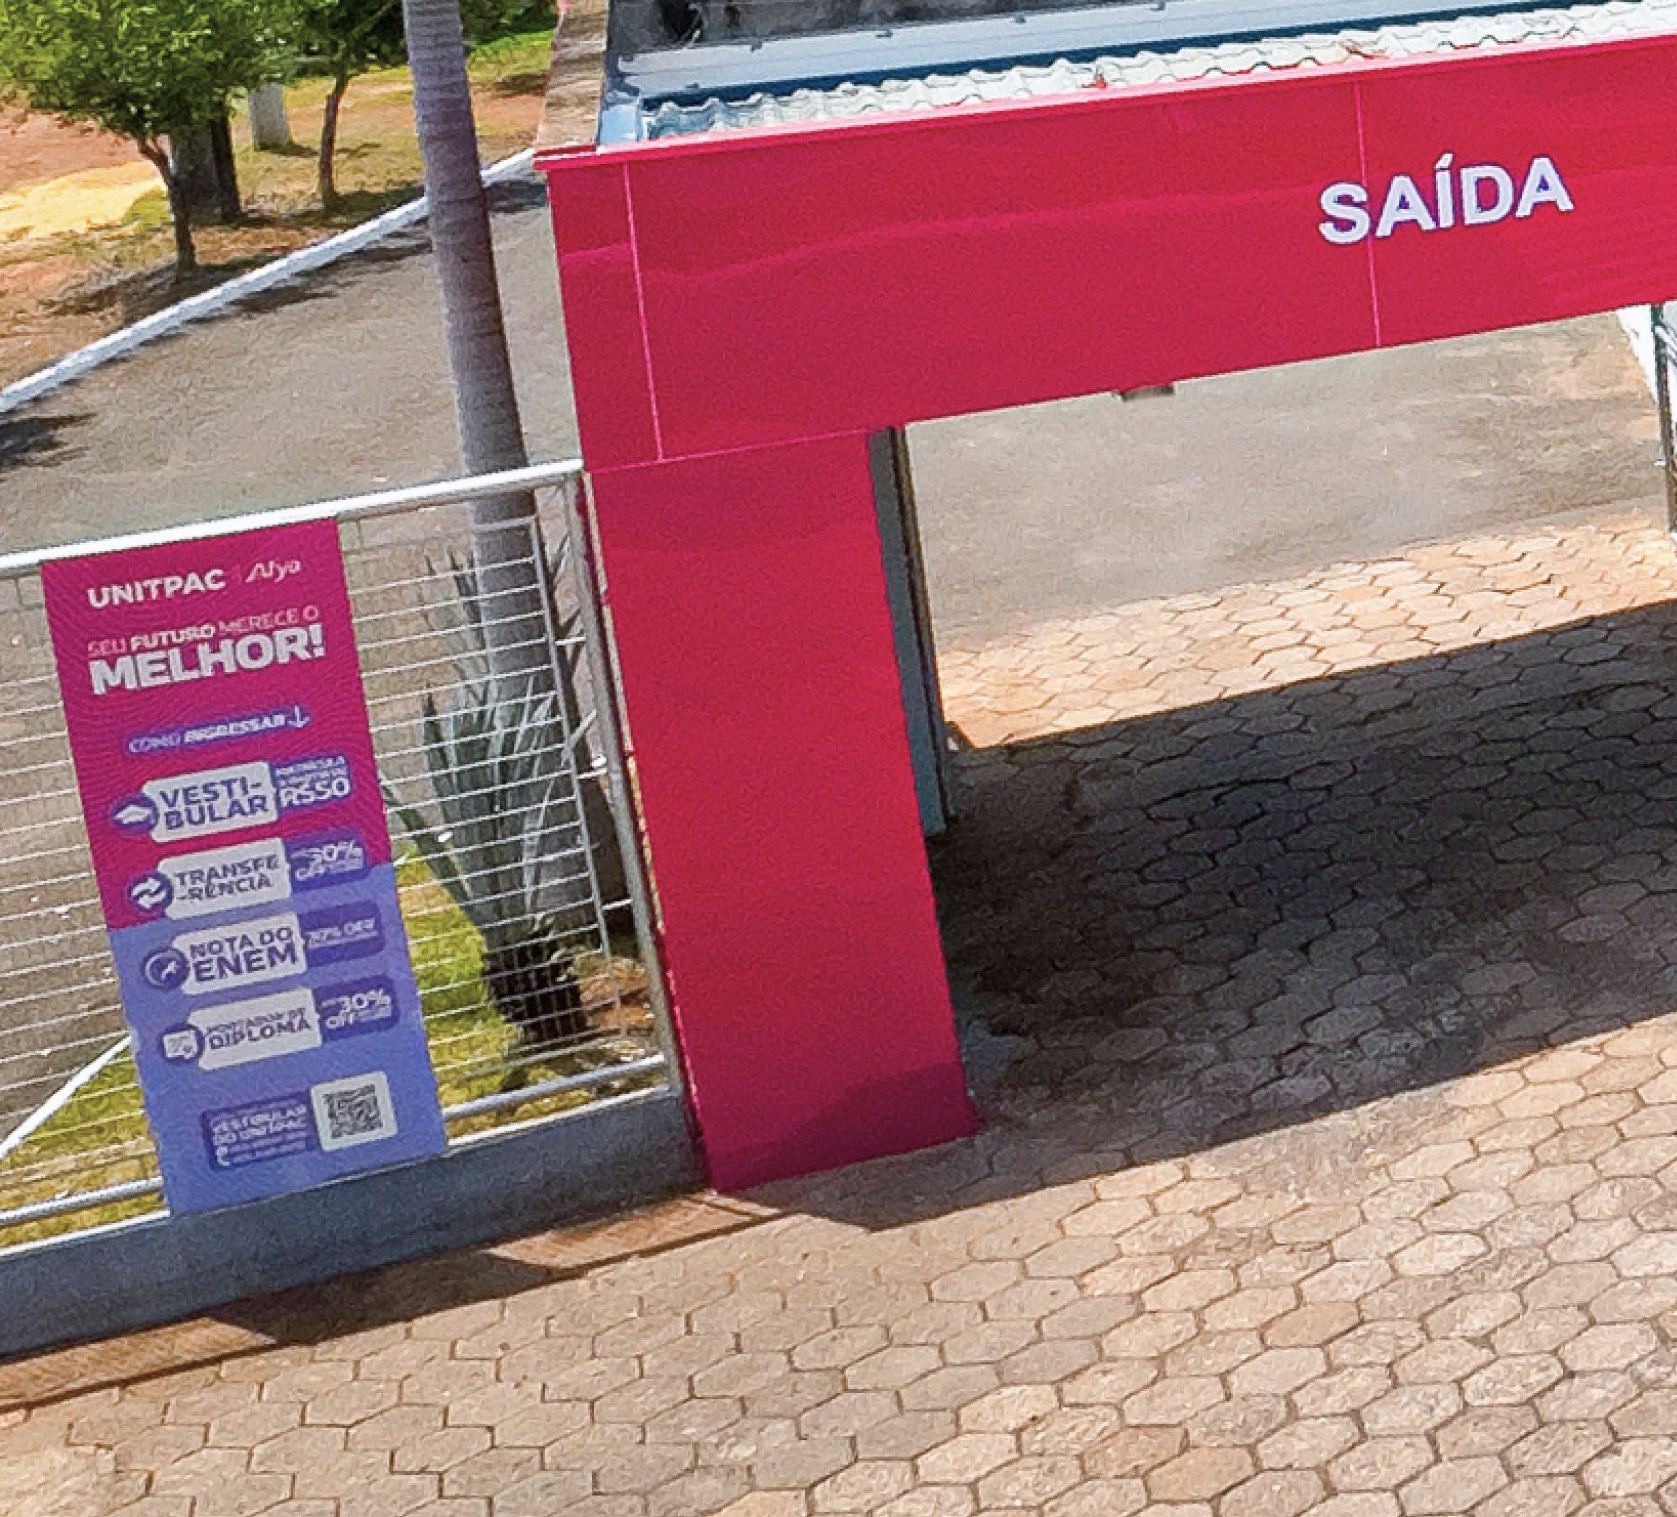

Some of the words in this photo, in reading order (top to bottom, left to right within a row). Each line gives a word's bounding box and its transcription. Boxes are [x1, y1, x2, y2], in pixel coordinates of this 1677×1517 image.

[1318, 152, 1575, 245] SAÍDA
[87, 569, 226, 609] UNITPAC
[87, 637, 127, 658] SEU
[131, 623, 216, 653] FUTURO
[218, 608, 299, 634] MERECE
[303, 604, 320, 622] O
[90, 623, 327, 695] MELHOR!
[159, 776, 261, 808] VESTI-
[163, 794, 269, 831] BULAR
[174, 854, 279, 886] TRANSFE
[189, 933, 254, 959] NOTA
[259, 926, 294, 946] DO
[193, 943, 299, 983] ENEM
[208, 1019, 312, 1050] DIPLOMA
